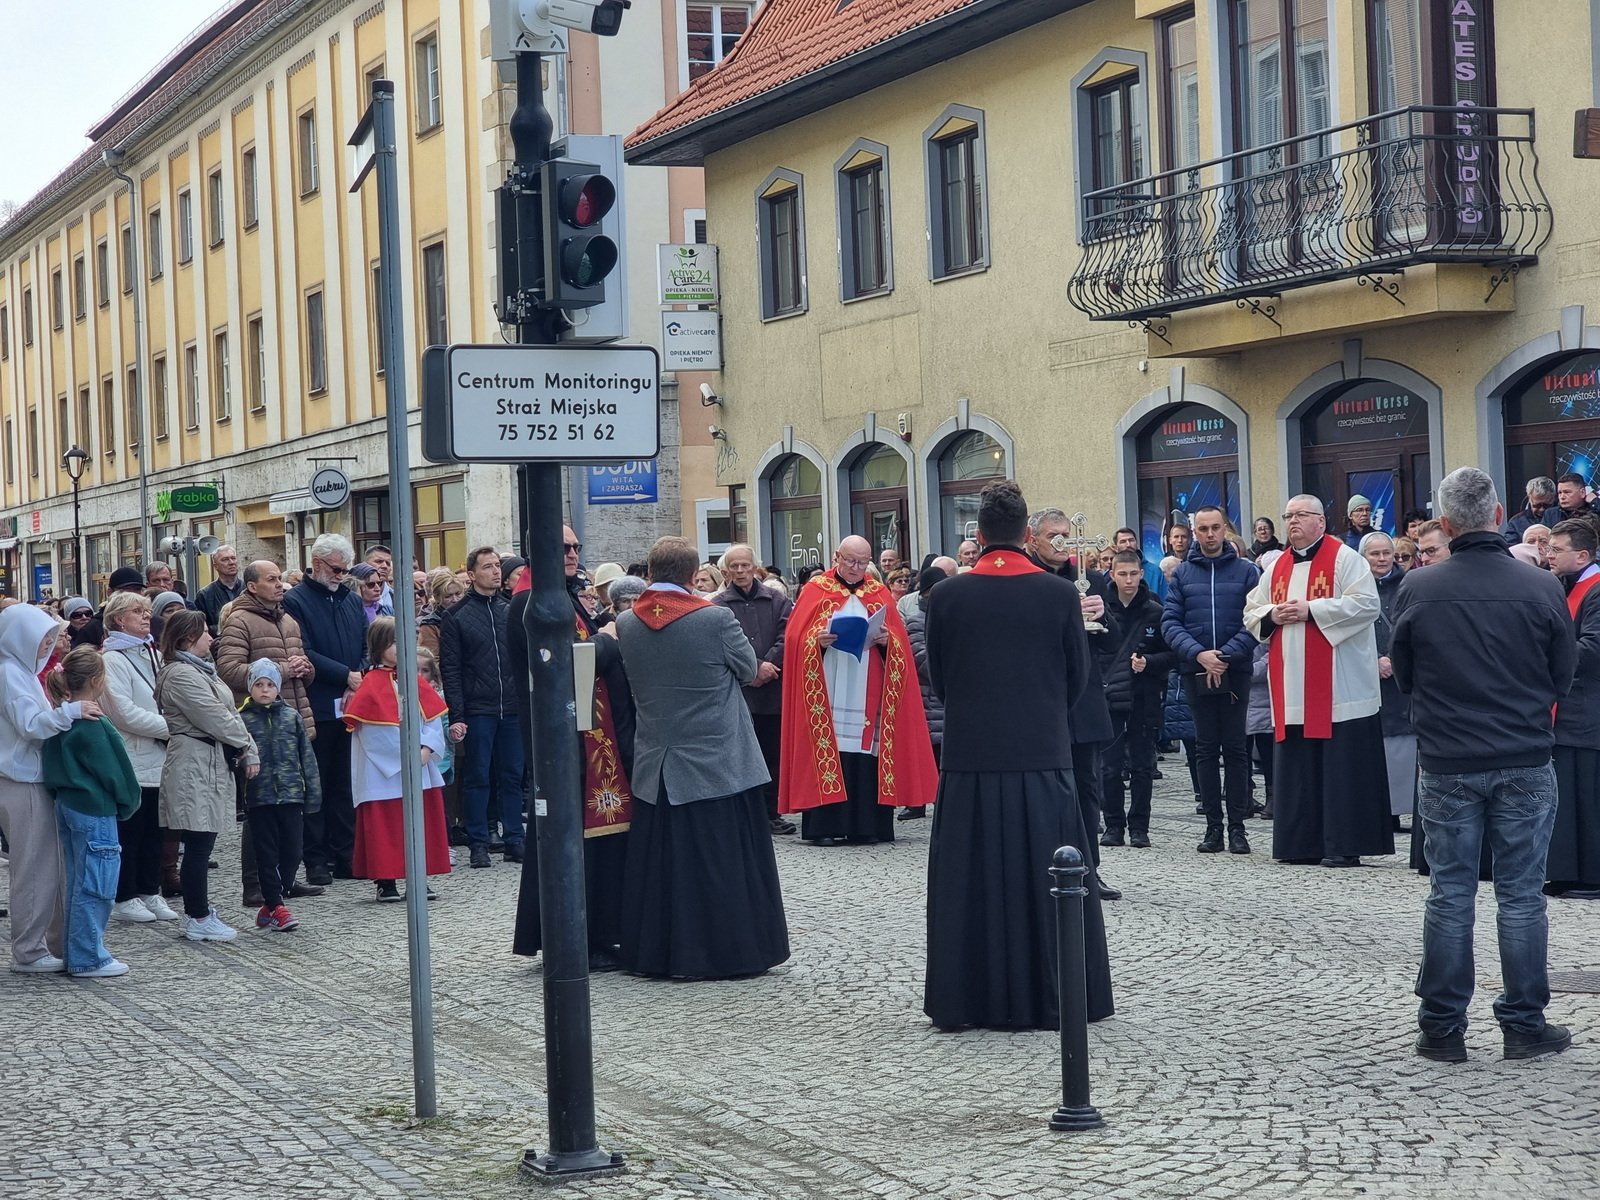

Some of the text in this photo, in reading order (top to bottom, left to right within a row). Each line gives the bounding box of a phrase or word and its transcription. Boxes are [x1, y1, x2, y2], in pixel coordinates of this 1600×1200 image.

[667, 268, 695, 280] Active
[674, 269, 711, 286] Care 24
[458, 372, 652, 394] Centrum Monitoringu
[496, 398, 617, 419] Straż Miejska
[498, 424, 615, 440] 75 752 51 62
[314, 480, 346, 494] cukru
[176, 492, 214, 502] żabka
